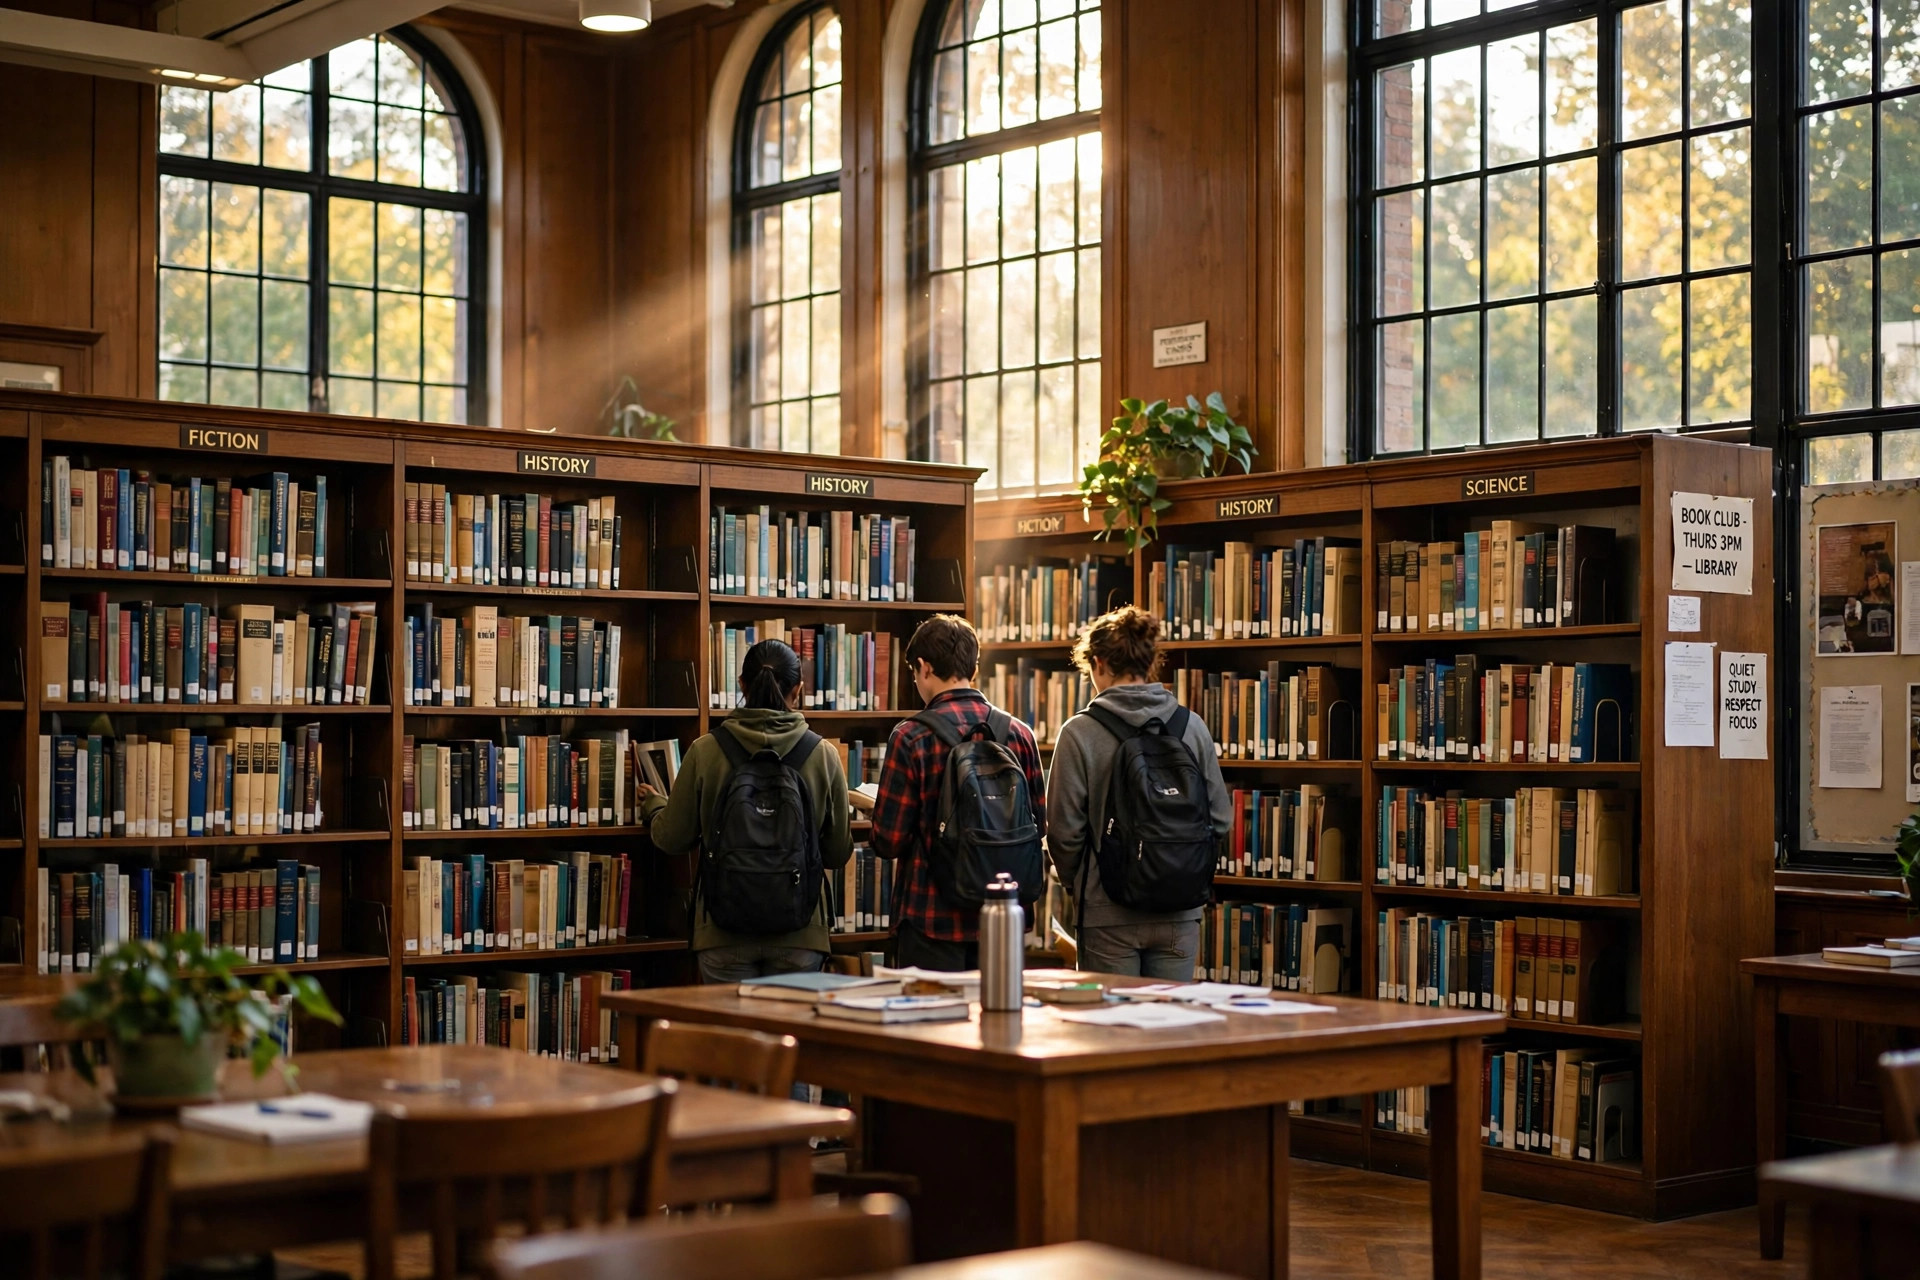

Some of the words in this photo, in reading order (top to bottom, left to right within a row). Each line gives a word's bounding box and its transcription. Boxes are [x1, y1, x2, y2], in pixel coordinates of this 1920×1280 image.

[189, 429, 259, 451] FICTION
[524, 454, 590, 474] HISTORY
[811, 476, 870, 495] HISTORY
[1466, 475, 1528, 496] SCIENCE
[1220, 498, 1274, 517] HISTORY
[1681, 507, 1712, 526] BOOK
[1713, 510, 1741, 528] CLUB
[1683, 531, 1718, 550] THURS
[1720, 534, 1742, 551] 3PM
[1695, 558, 1738, 577] LIBRARY
[1729, 662, 1756, 678] QUIET
[1728, 679, 1757, 694] STUDY
[1725, 697, 1762, 712] RESPECT
[1729, 715, 1758, 730] FOCUS
